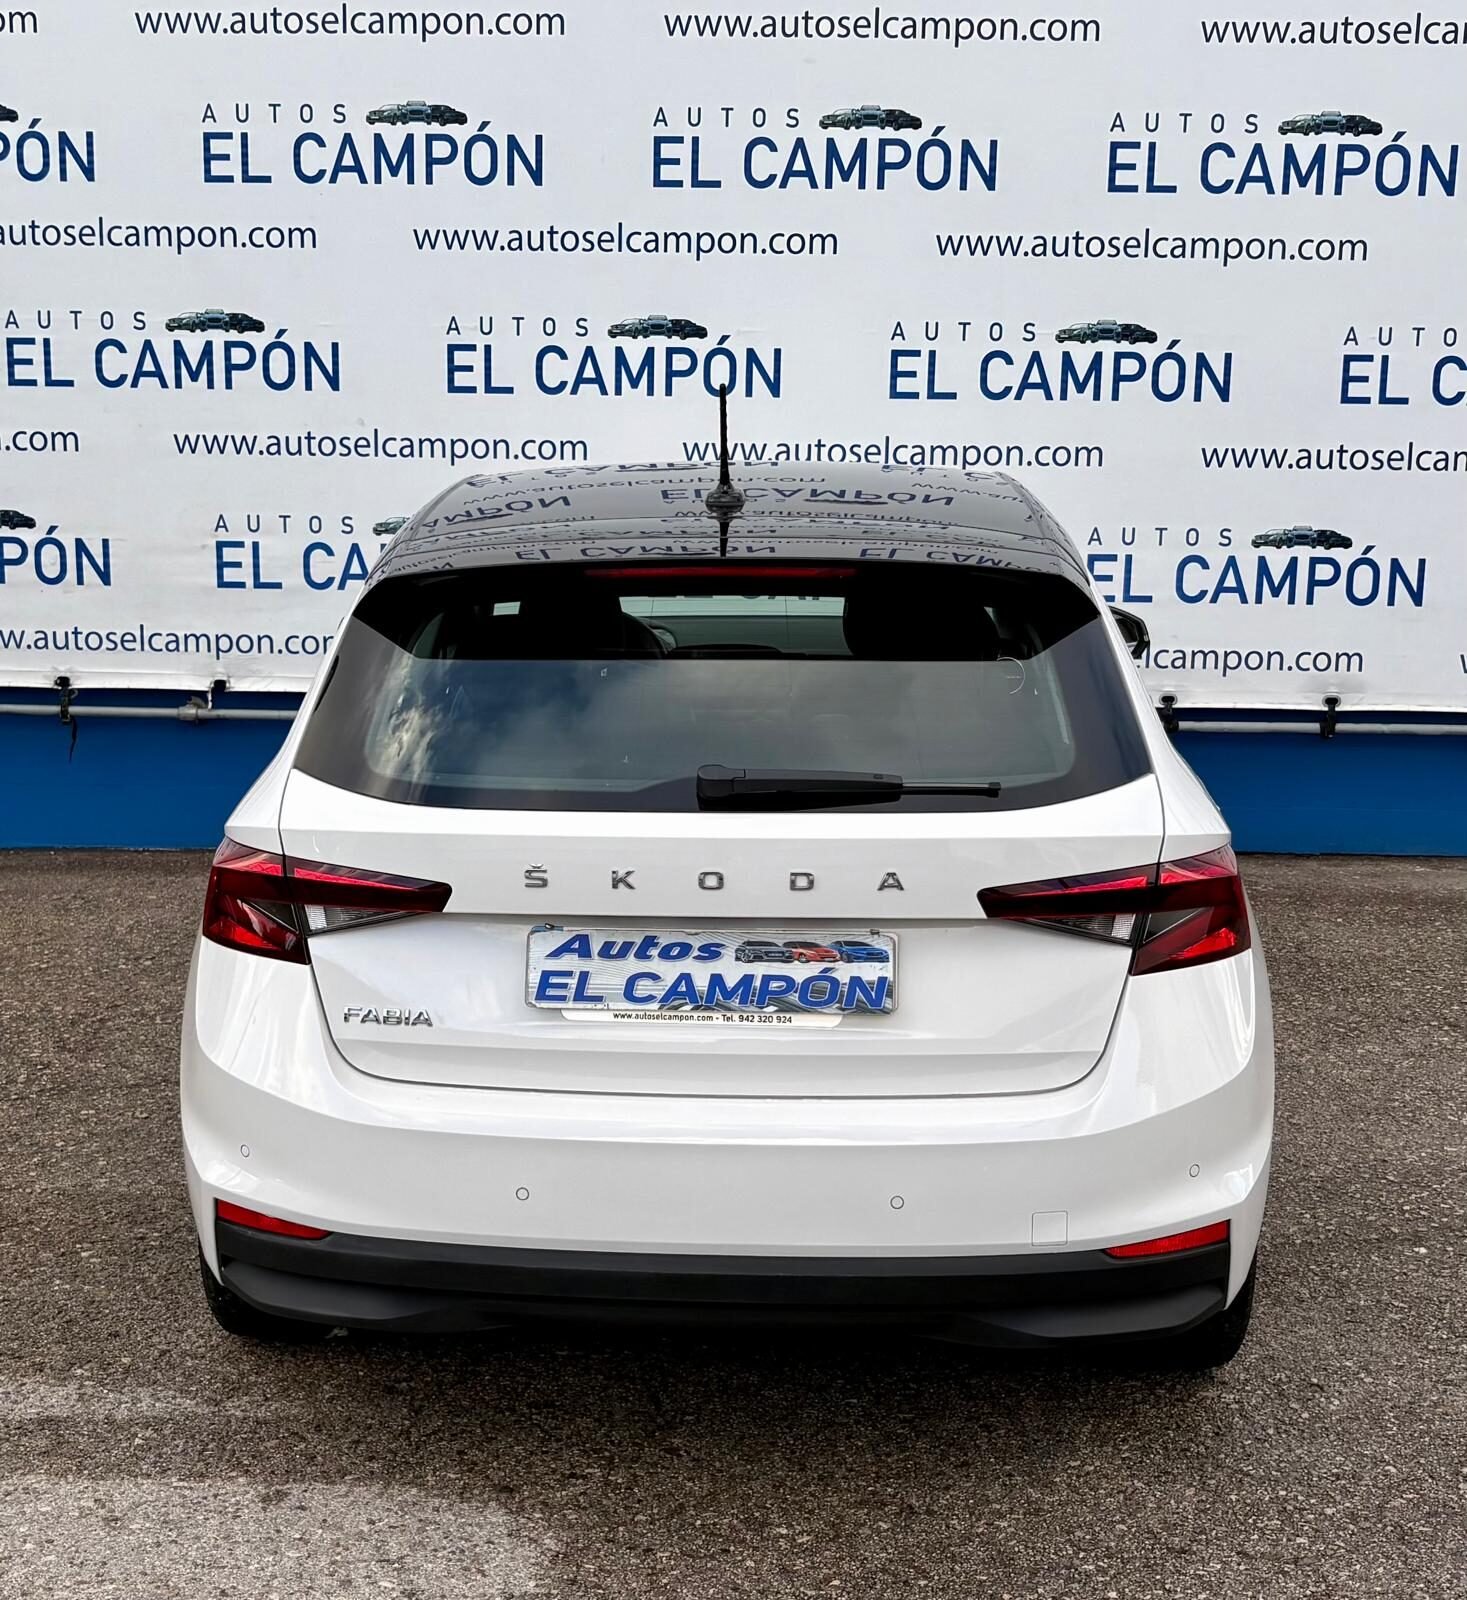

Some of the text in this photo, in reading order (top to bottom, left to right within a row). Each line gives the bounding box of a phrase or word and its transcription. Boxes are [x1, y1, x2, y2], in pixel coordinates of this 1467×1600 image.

[135, 3, 564, 42] www.autoselcampon.com
[664, 7, 1099, 48] www.autoselcampon.com
[1201, 13, 1467, 44] www.autoselca
[202, 103, 346, 123] AUTOS
[653, 107, 799, 128] AUTOS
[1110, 112, 1258, 134] AUTOS
[0, 118, 95, 182] ÓN
[203, 121, 543, 186] EL CAMPÓN
[653, 127, 998, 191] EL CAMPÓN
[1108, 131, 1459, 196] EL CAMPÓN
[413, 222, 837, 261] www.autoselcampon.com
[936, 228, 1367, 267] www.autoselcampon.com
[5, 310, 146, 330] AUTOS
[446, 316, 588, 337] AUTOS
[891, 321, 1035, 342] AUTOS
[1344, 326, 1457, 347] AUTO
[6, 329, 340, 391] EL CAMPÓN
[447, 335, 781, 397] EL CAMPÓN
[889, 340, 1232, 402] EL CAMPÓN
[1340, 354, 1409, 405] EL
[0, 431, 79, 452] .com
[173, 428, 588, 466] www.autoselcampon.com
[683, 436, 1104, 469] www.autoselcampon.com
[214, 514, 353, 534] AUTOS
[1088, 527, 1231, 547] AUTOS
[216, 541, 386, 590] EL CA
[1087, 545, 1426, 607] EL CAMPÓN
[1137, 646, 1363, 678] lcampon.com
[523, 864, 905, 892] ŠKODA
[544, 933, 727, 963] Autos
[534, 967, 888, 1009] EL CAMPÓN
[343, 1005, 434, 1028] FABIA
[613, 1012, 714, 1023] www.autoselcampon.com
[722, 1014, 736, 1023] Tel.
[738, 1014, 755, 1023] 942
[757, 1015, 774, 1024] 320
[775, 1016, 793, 1025] 924
